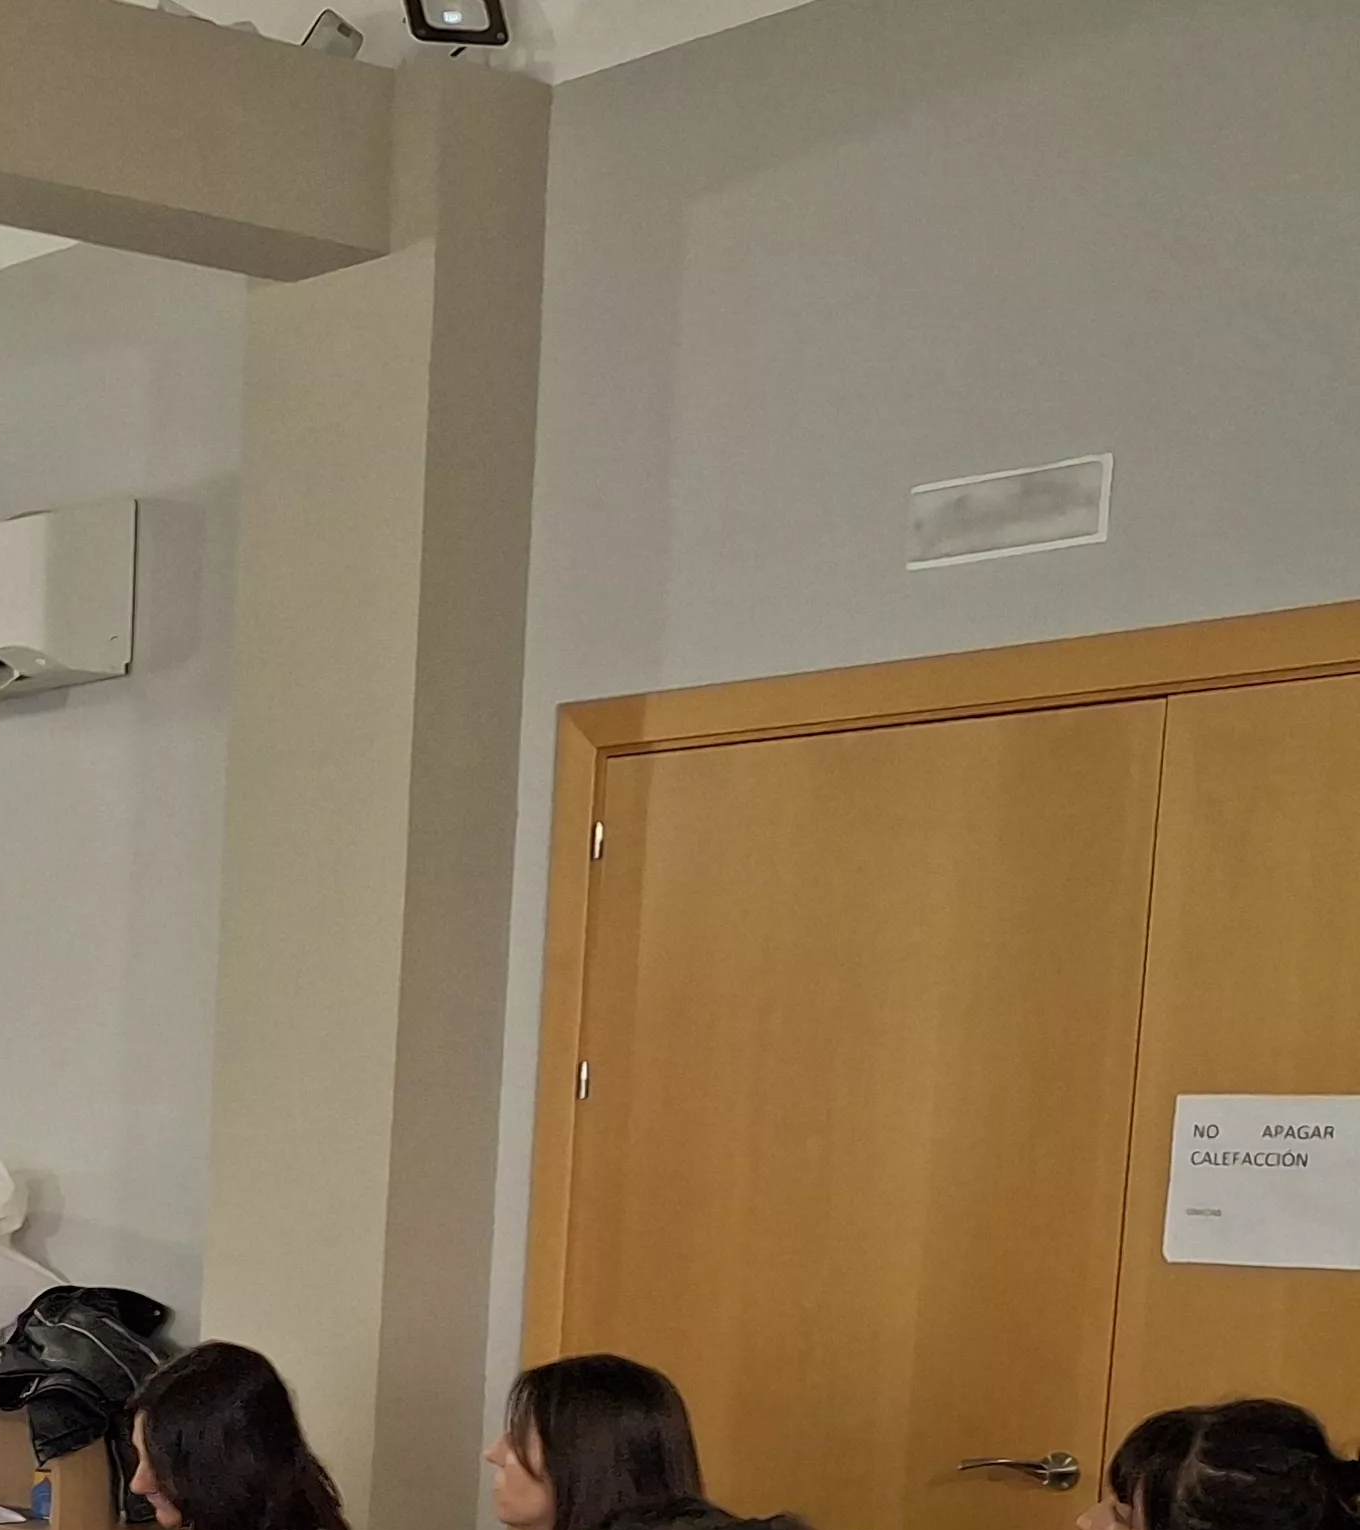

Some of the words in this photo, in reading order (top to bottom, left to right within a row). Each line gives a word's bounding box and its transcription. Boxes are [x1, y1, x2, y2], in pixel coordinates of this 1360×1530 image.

[1192, 1124, 1220, 1139] NO
[1261, 1124, 1336, 1140] APAGAR
[1190, 1149, 1310, 1168] CALEFACCIÓN
